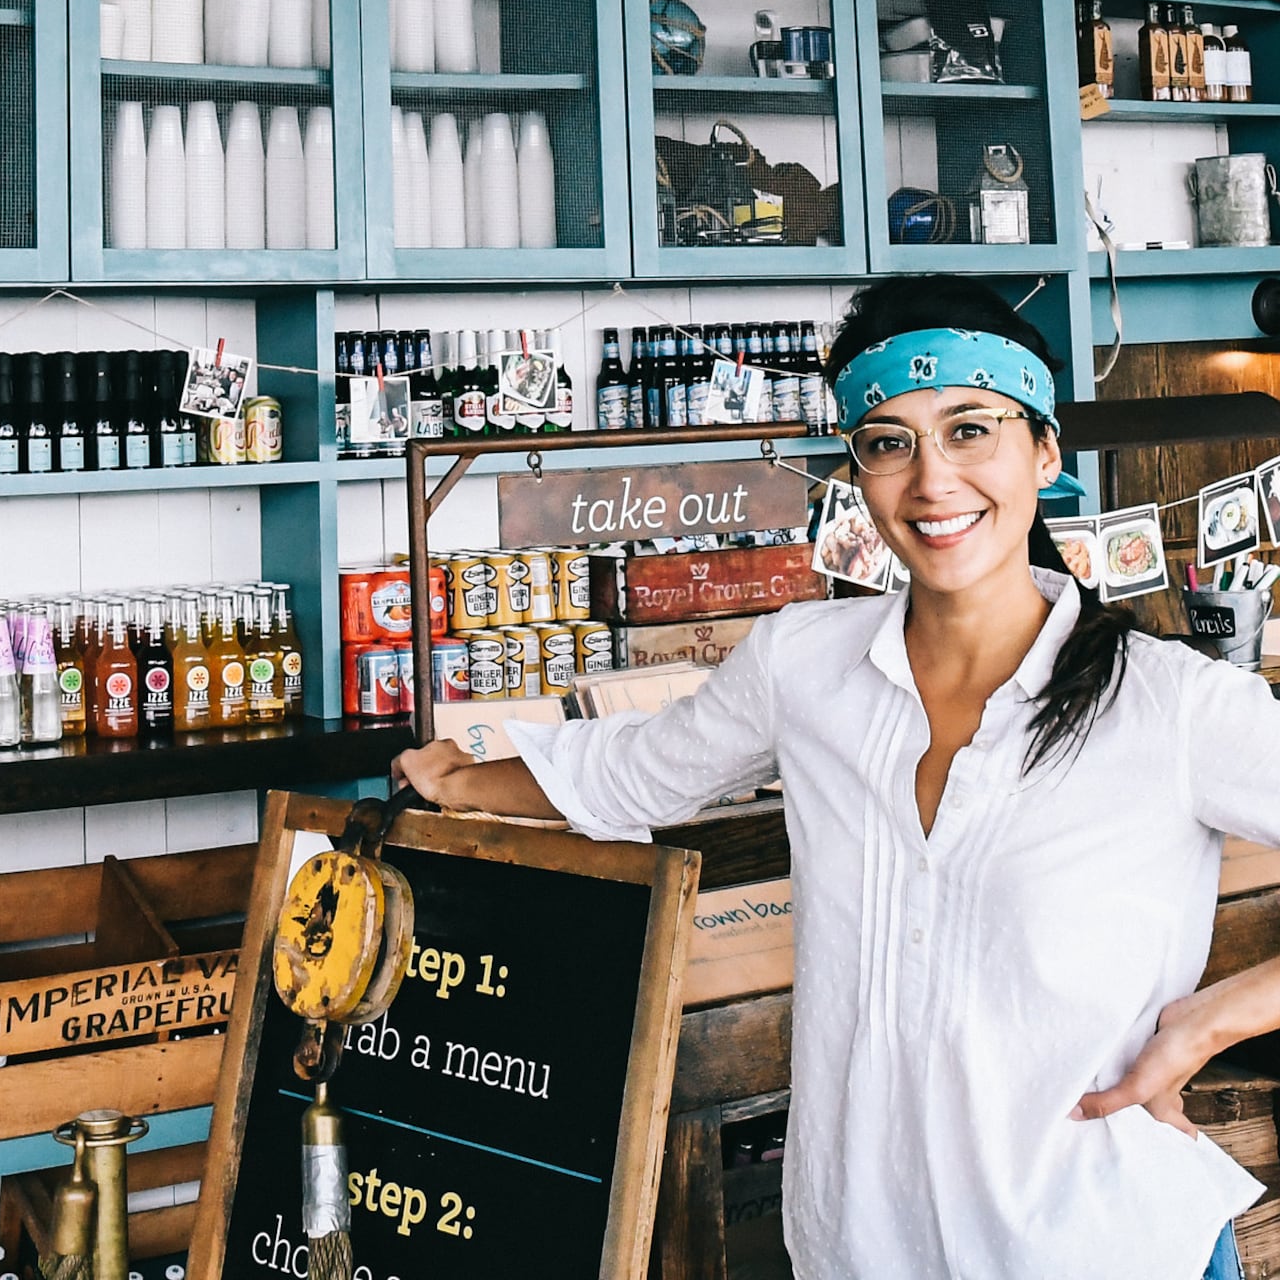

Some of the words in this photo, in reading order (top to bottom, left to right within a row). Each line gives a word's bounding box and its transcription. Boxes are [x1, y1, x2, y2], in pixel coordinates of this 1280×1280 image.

[570, 477, 666, 535] take
[678, 483, 748, 525] out
[634, 583, 694, 611] Royal
[189, 691, 208, 701] IZZE
[224, 687, 244, 698] IZZE
[252, 682, 272, 693] IZZE
[109, 698, 130, 709] IZZE
[148, 692, 168, 703] IZZE
[693, 909, 751, 930] rown
[405, 939, 466, 999] tep
[476, 953, 509, 998] 1:
[122, 993, 161, 1006] GROWN
[342, 1009, 401, 1063] rab
[411, 1034, 431, 1071] a
[442, 1040, 551, 1100] menu
[347, 1168, 428, 1237] step
[437, 1190, 477, 1241] 2:
